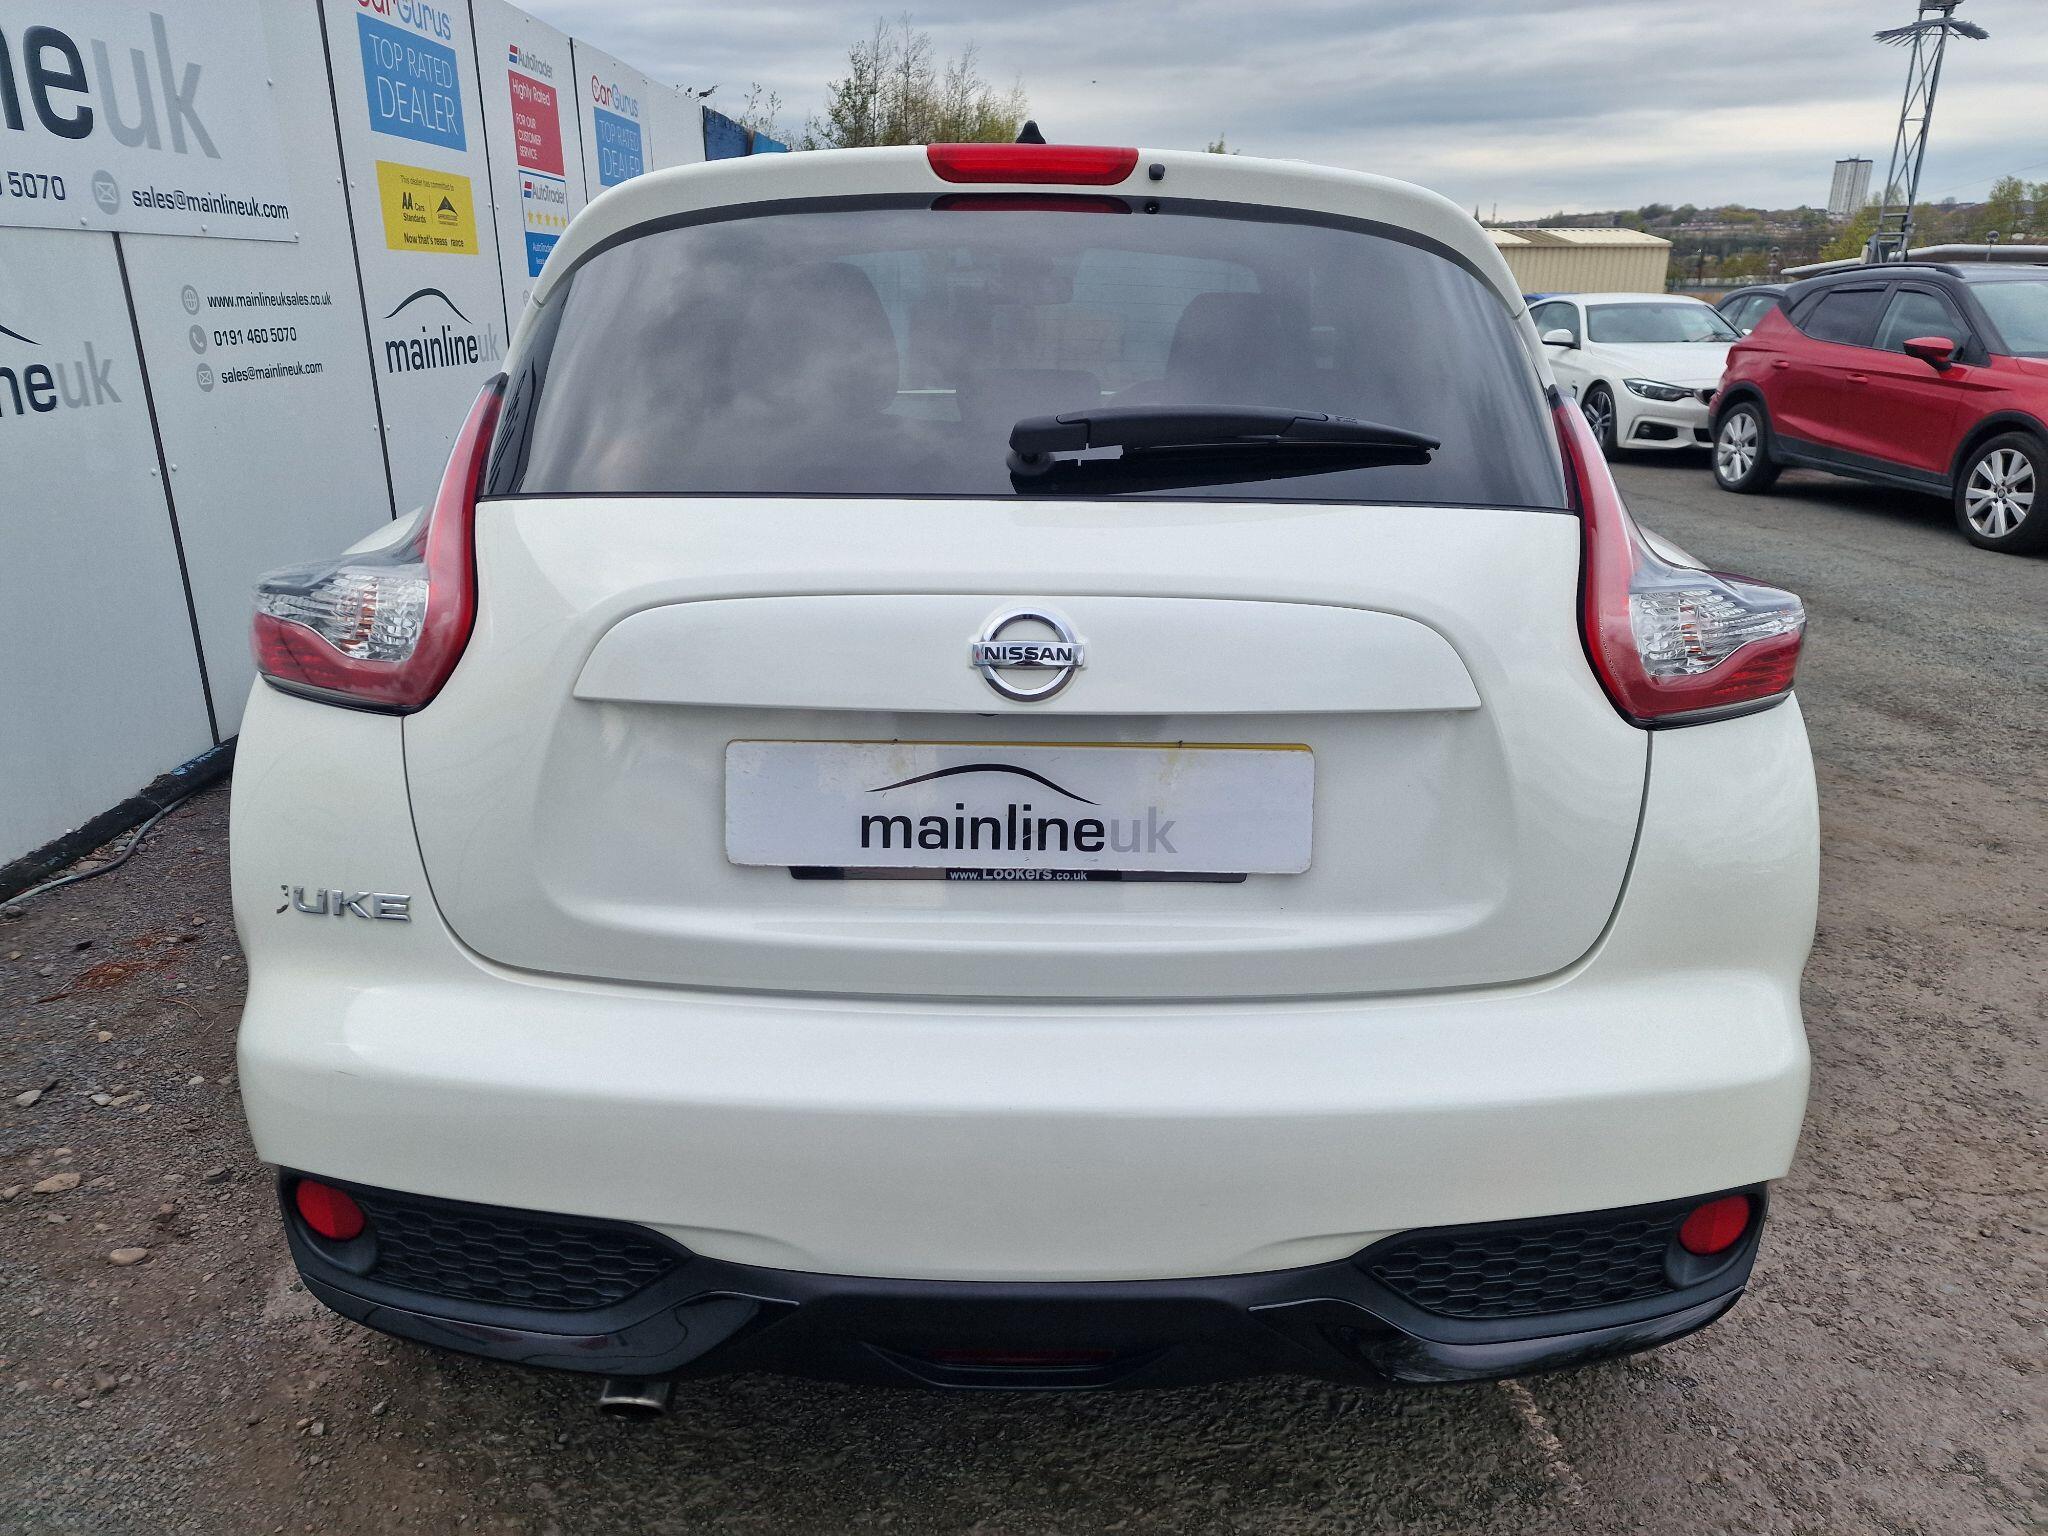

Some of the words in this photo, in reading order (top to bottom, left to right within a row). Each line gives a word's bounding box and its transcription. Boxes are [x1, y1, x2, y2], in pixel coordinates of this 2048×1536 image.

[369, 33, 402, 71] TOP
[407, 48, 452, 88] RATED
[518, 48, 553, 79] AutoTrader
[512, 79, 532, 102] Highly
[533, 86, 551, 107] Rated
[592, 75, 638, 118] CarGurus
[377, 76, 459, 136] DEALER
[516, 112, 526, 126] FOR
[527, 116, 537, 129] OUR
[518, 129, 542, 146] CUSTOMER
[599, 120, 615, 142] TOP
[618, 126, 639, 152] RATED
[519, 144, 538, 160] SERVICE
[7, 171, 67, 201] 5070
[532, 182, 565, 205] AutoTrader
[131, 186, 289, 220] sales@mainlineuk.com
[402, 192, 413, 210] AA
[414, 202, 425, 212] Cars
[403, 212, 427, 224] Standards
[403, 232, 417, 244] Now
[418, 234, 433, 246] that's
[207, 291, 332, 308] www.mainlineuksales.co.uk
[213, 329, 244, 347] 0191
[246, 328, 269, 344] 460
[271, 326, 297, 343] 5070
[385, 322, 500, 374] mainlineuk
[221, 361, 324, 384] sales@mainlineuk.com
[984, 646, 1072, 661] NISSAN
[860, 802, 1178, 854] mainlineuk
[949, 867, 1088, 881] www.Lookers.co.uk
